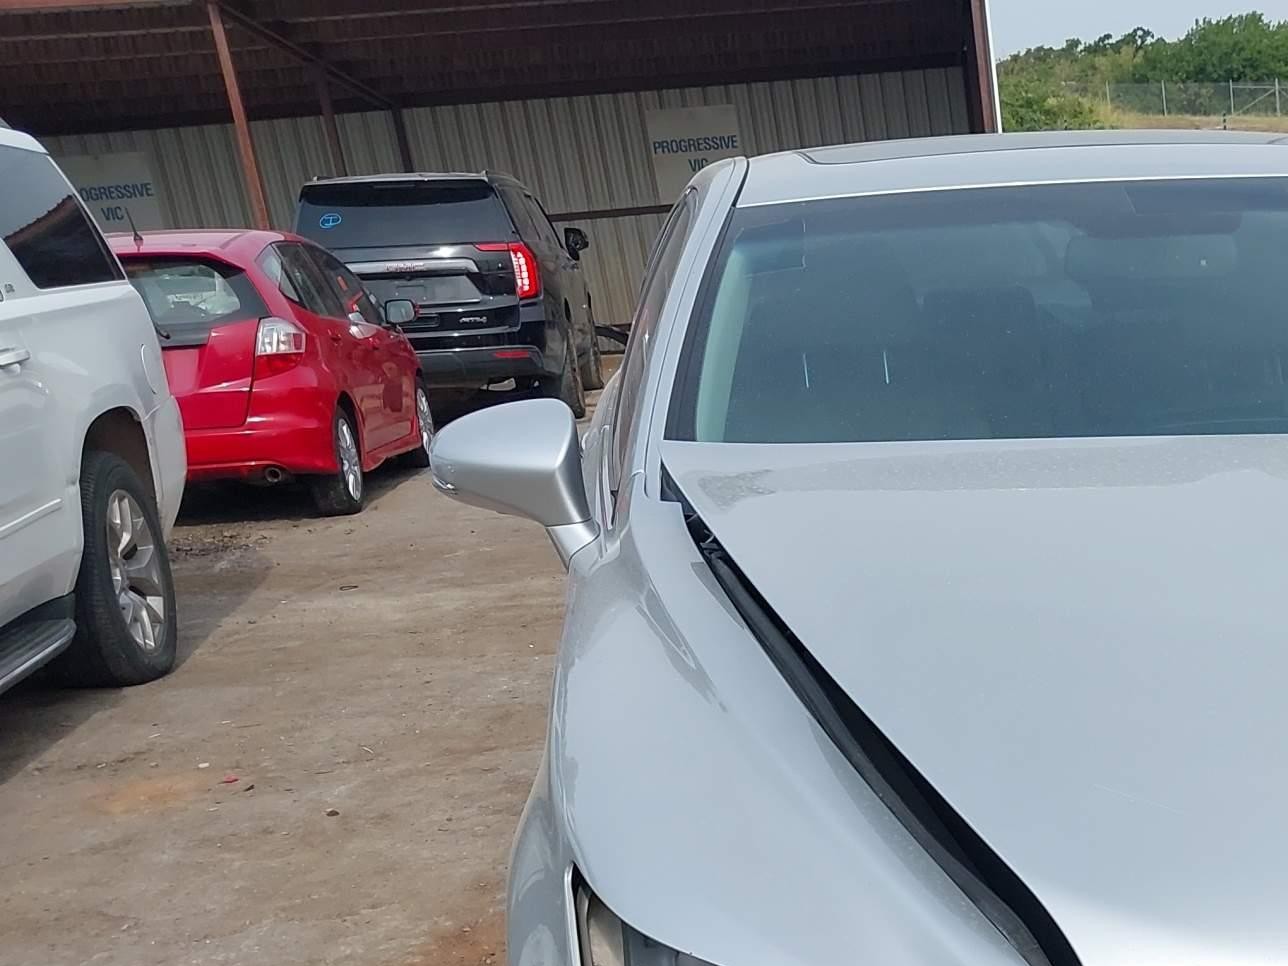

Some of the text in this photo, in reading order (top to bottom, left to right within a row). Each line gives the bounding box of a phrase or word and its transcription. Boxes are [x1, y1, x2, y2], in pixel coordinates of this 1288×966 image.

[653, 134, 738, 154] PROGRESSIVE
[80, 182, 154, 203] OGRESSIVE
[101, 206, 124, 221] VIC
